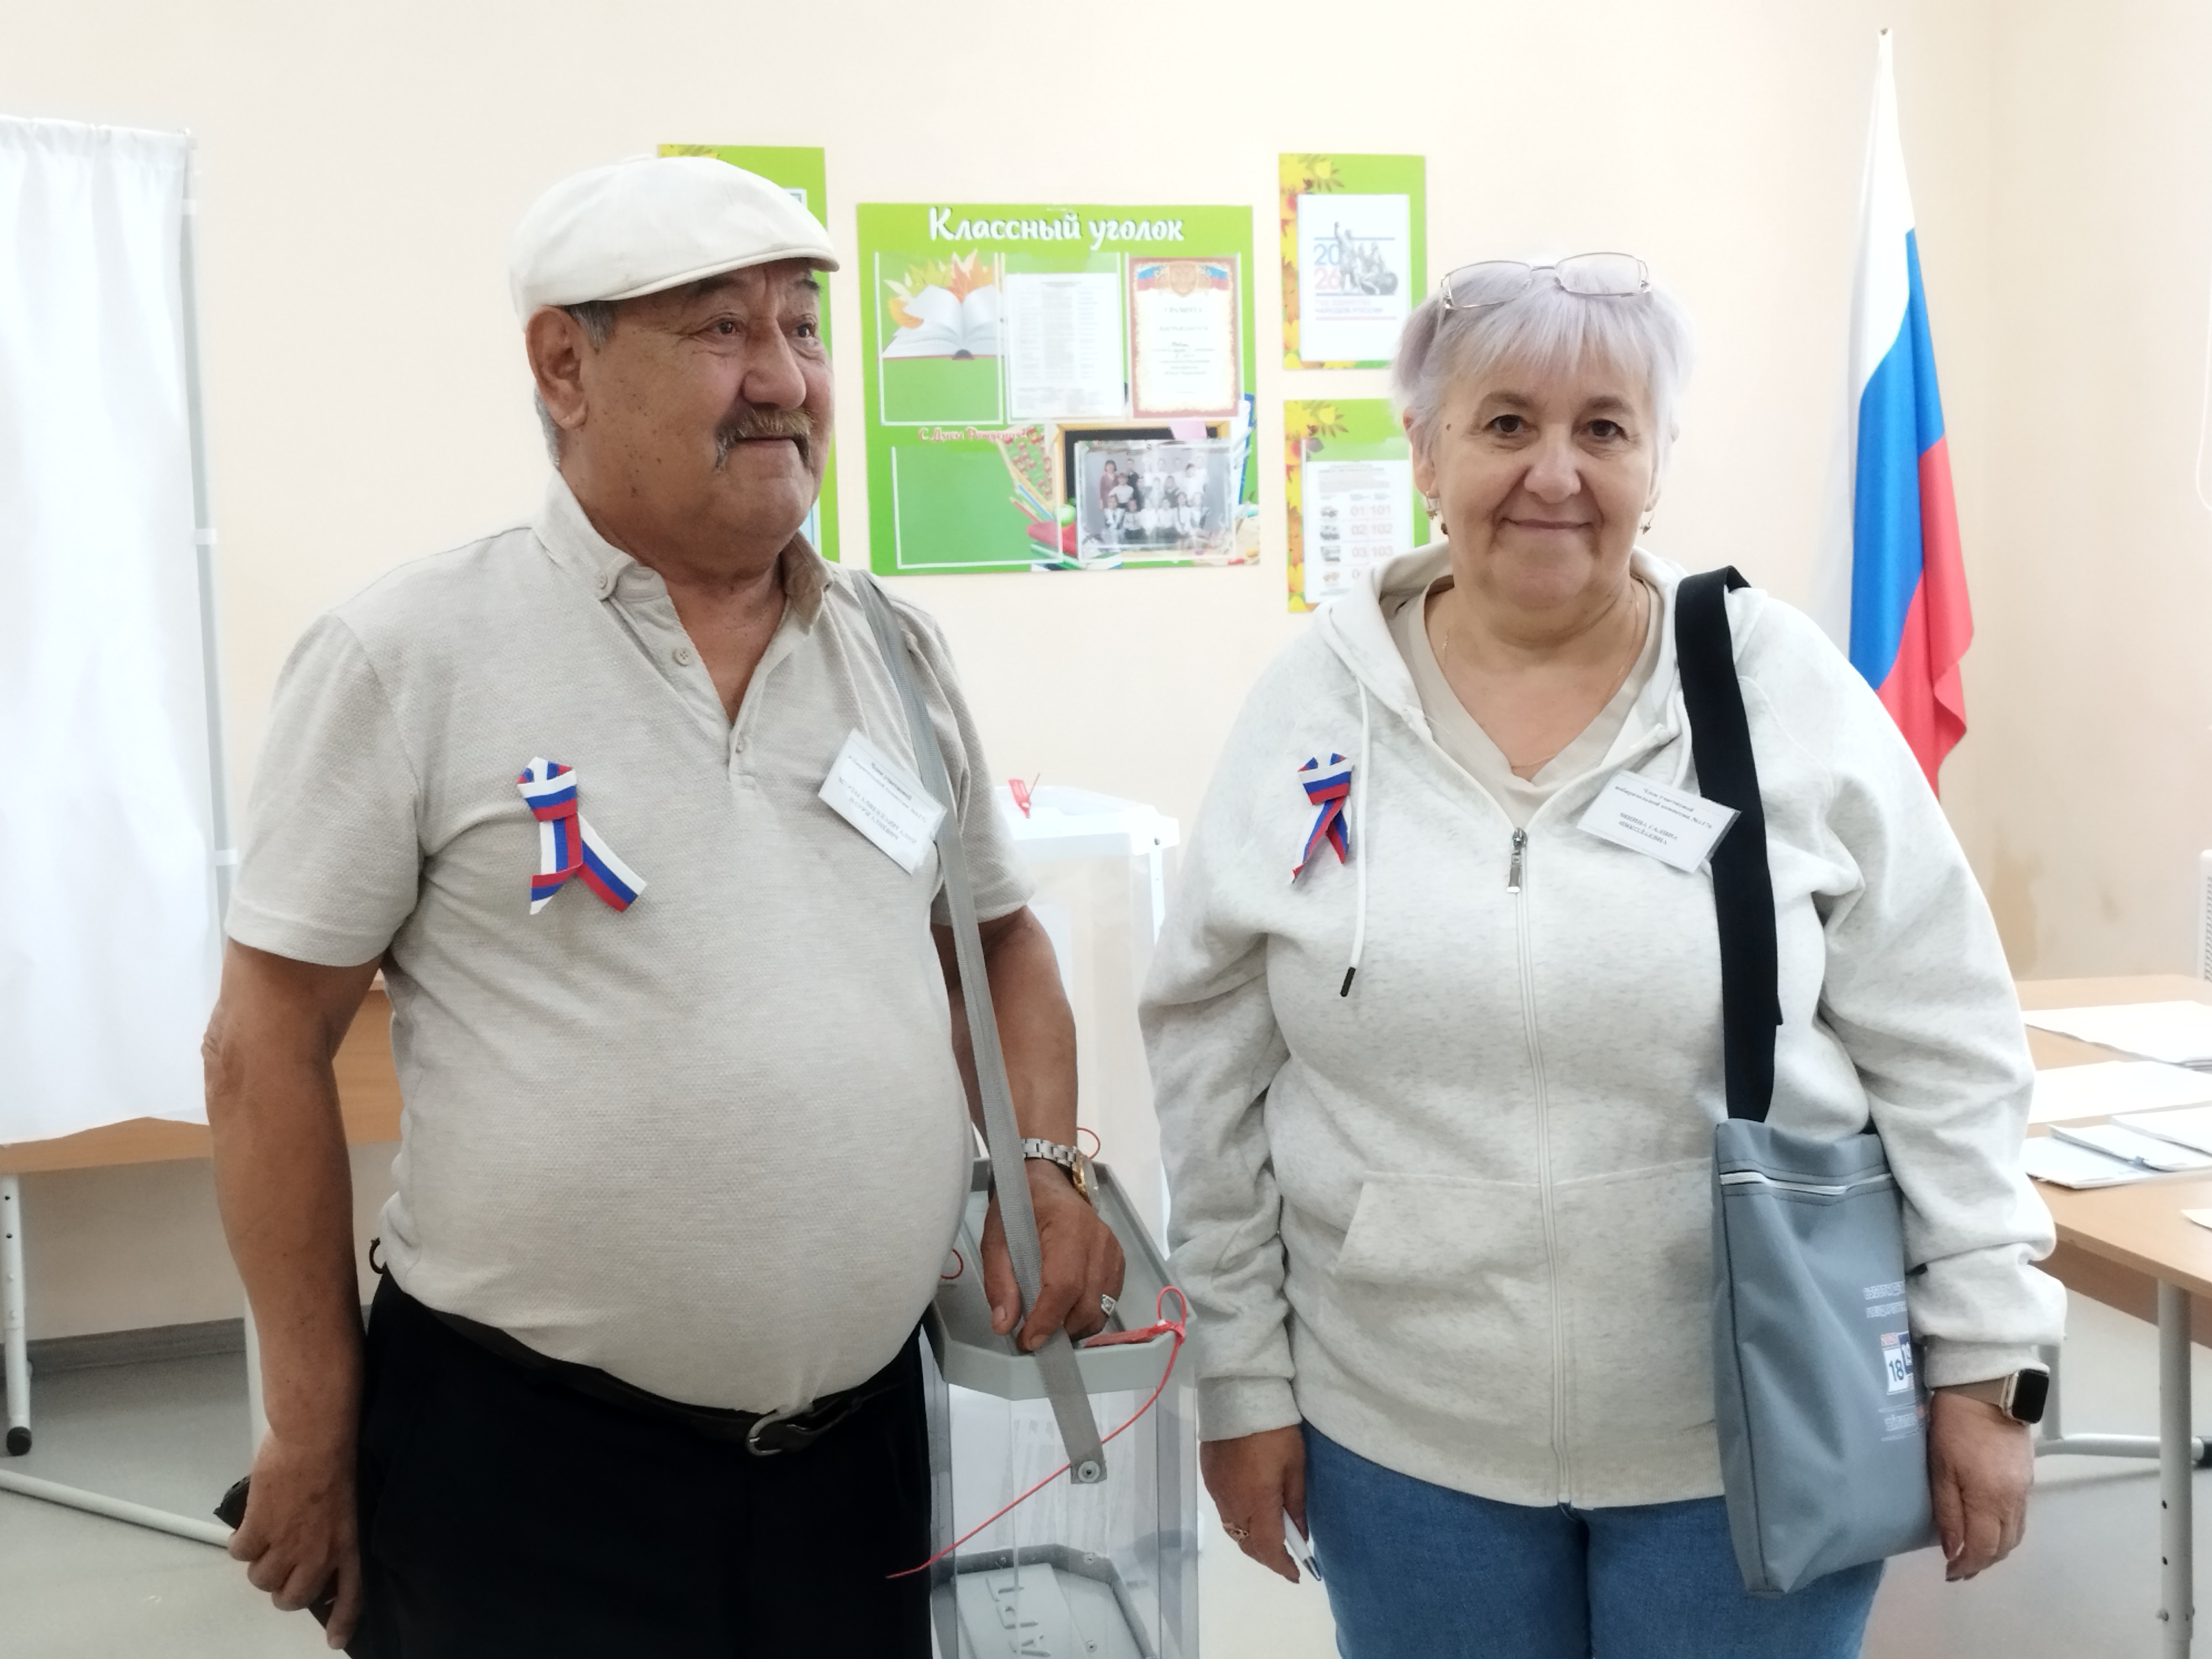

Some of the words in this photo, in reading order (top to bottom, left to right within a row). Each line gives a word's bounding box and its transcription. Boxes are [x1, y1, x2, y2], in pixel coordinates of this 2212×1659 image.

[928, 207, 1082, 241] Классный
[1088, 219, 1184, 251] уголок
[1314, 244, 1340, 265] 20
[1350, 505, 1365, 516] 01
[1369, 504, 1391, 515] 101
[1351, 524, 1366, 535] 02
[1371, 523, 1393, 534] 102
[1352, 547, 1366, 557] 03
[1371, 545, 1393, 557] 103
[1889, 1359, 1904, 1382] 18
